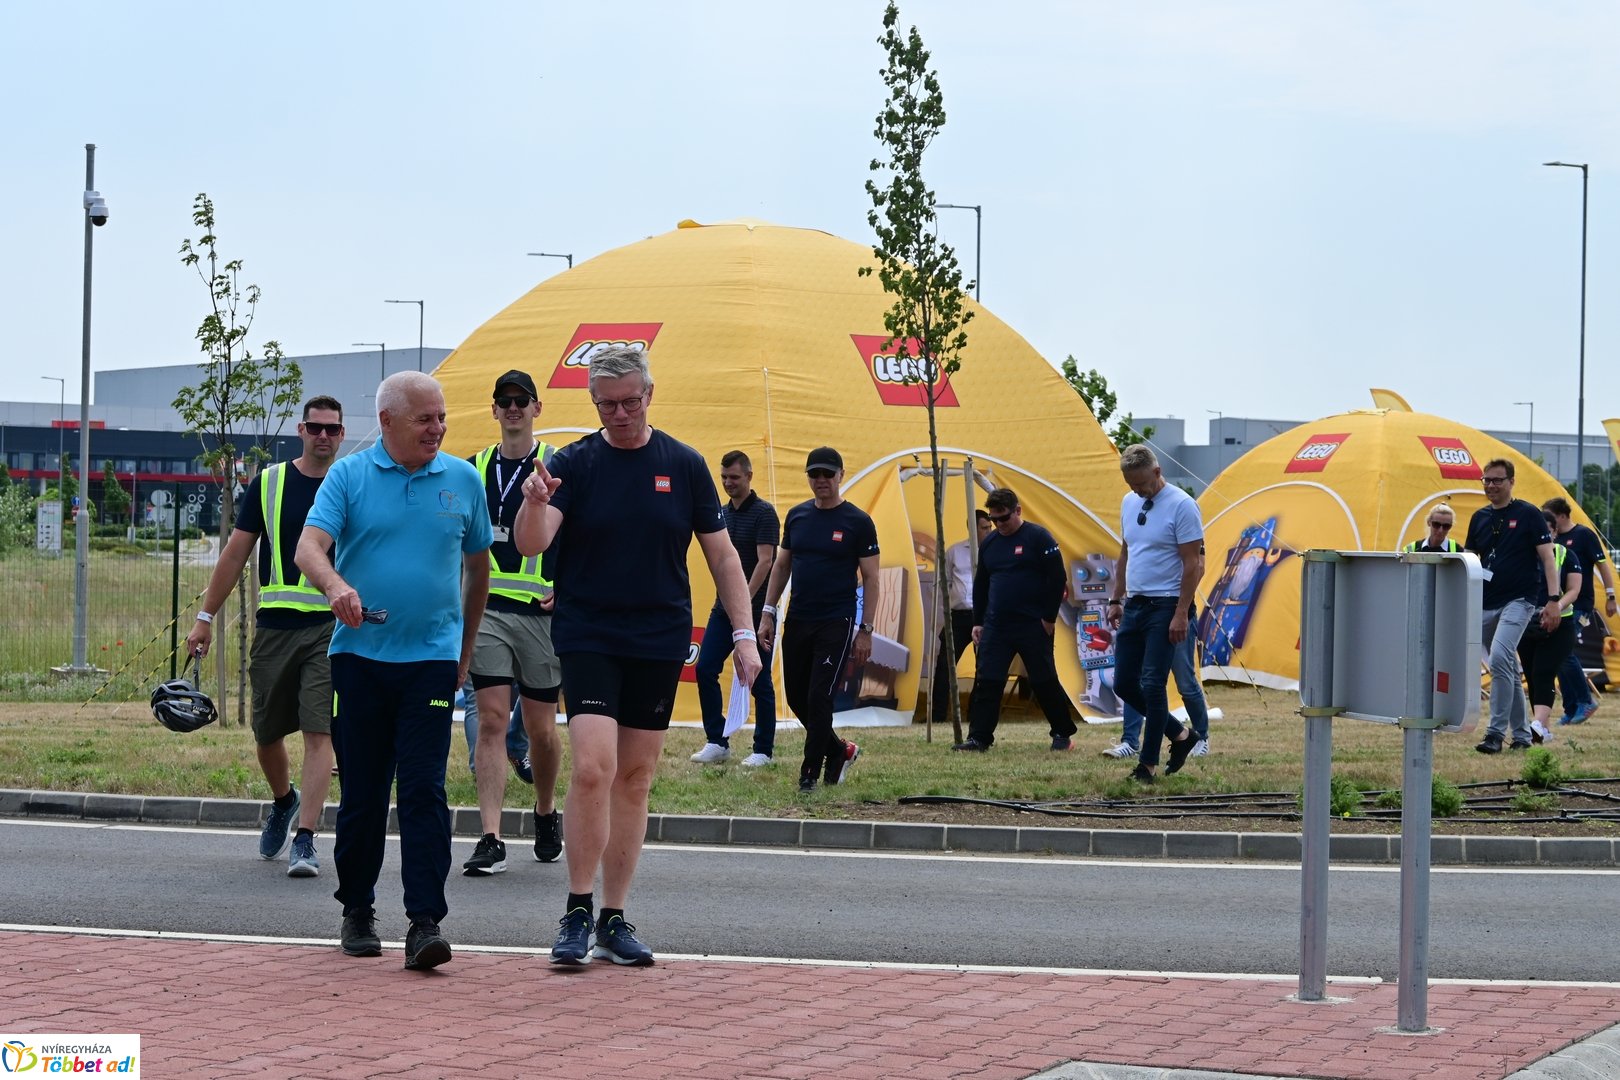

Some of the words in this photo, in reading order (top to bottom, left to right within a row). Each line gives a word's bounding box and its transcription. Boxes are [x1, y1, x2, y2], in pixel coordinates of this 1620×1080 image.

[874, 356, 937, 382] LEGO
[1296, 444, 1338, 459] LEGO
[1434, 448, 1471, 465] LEGO
[429, 699, 449, 708] JAKO
